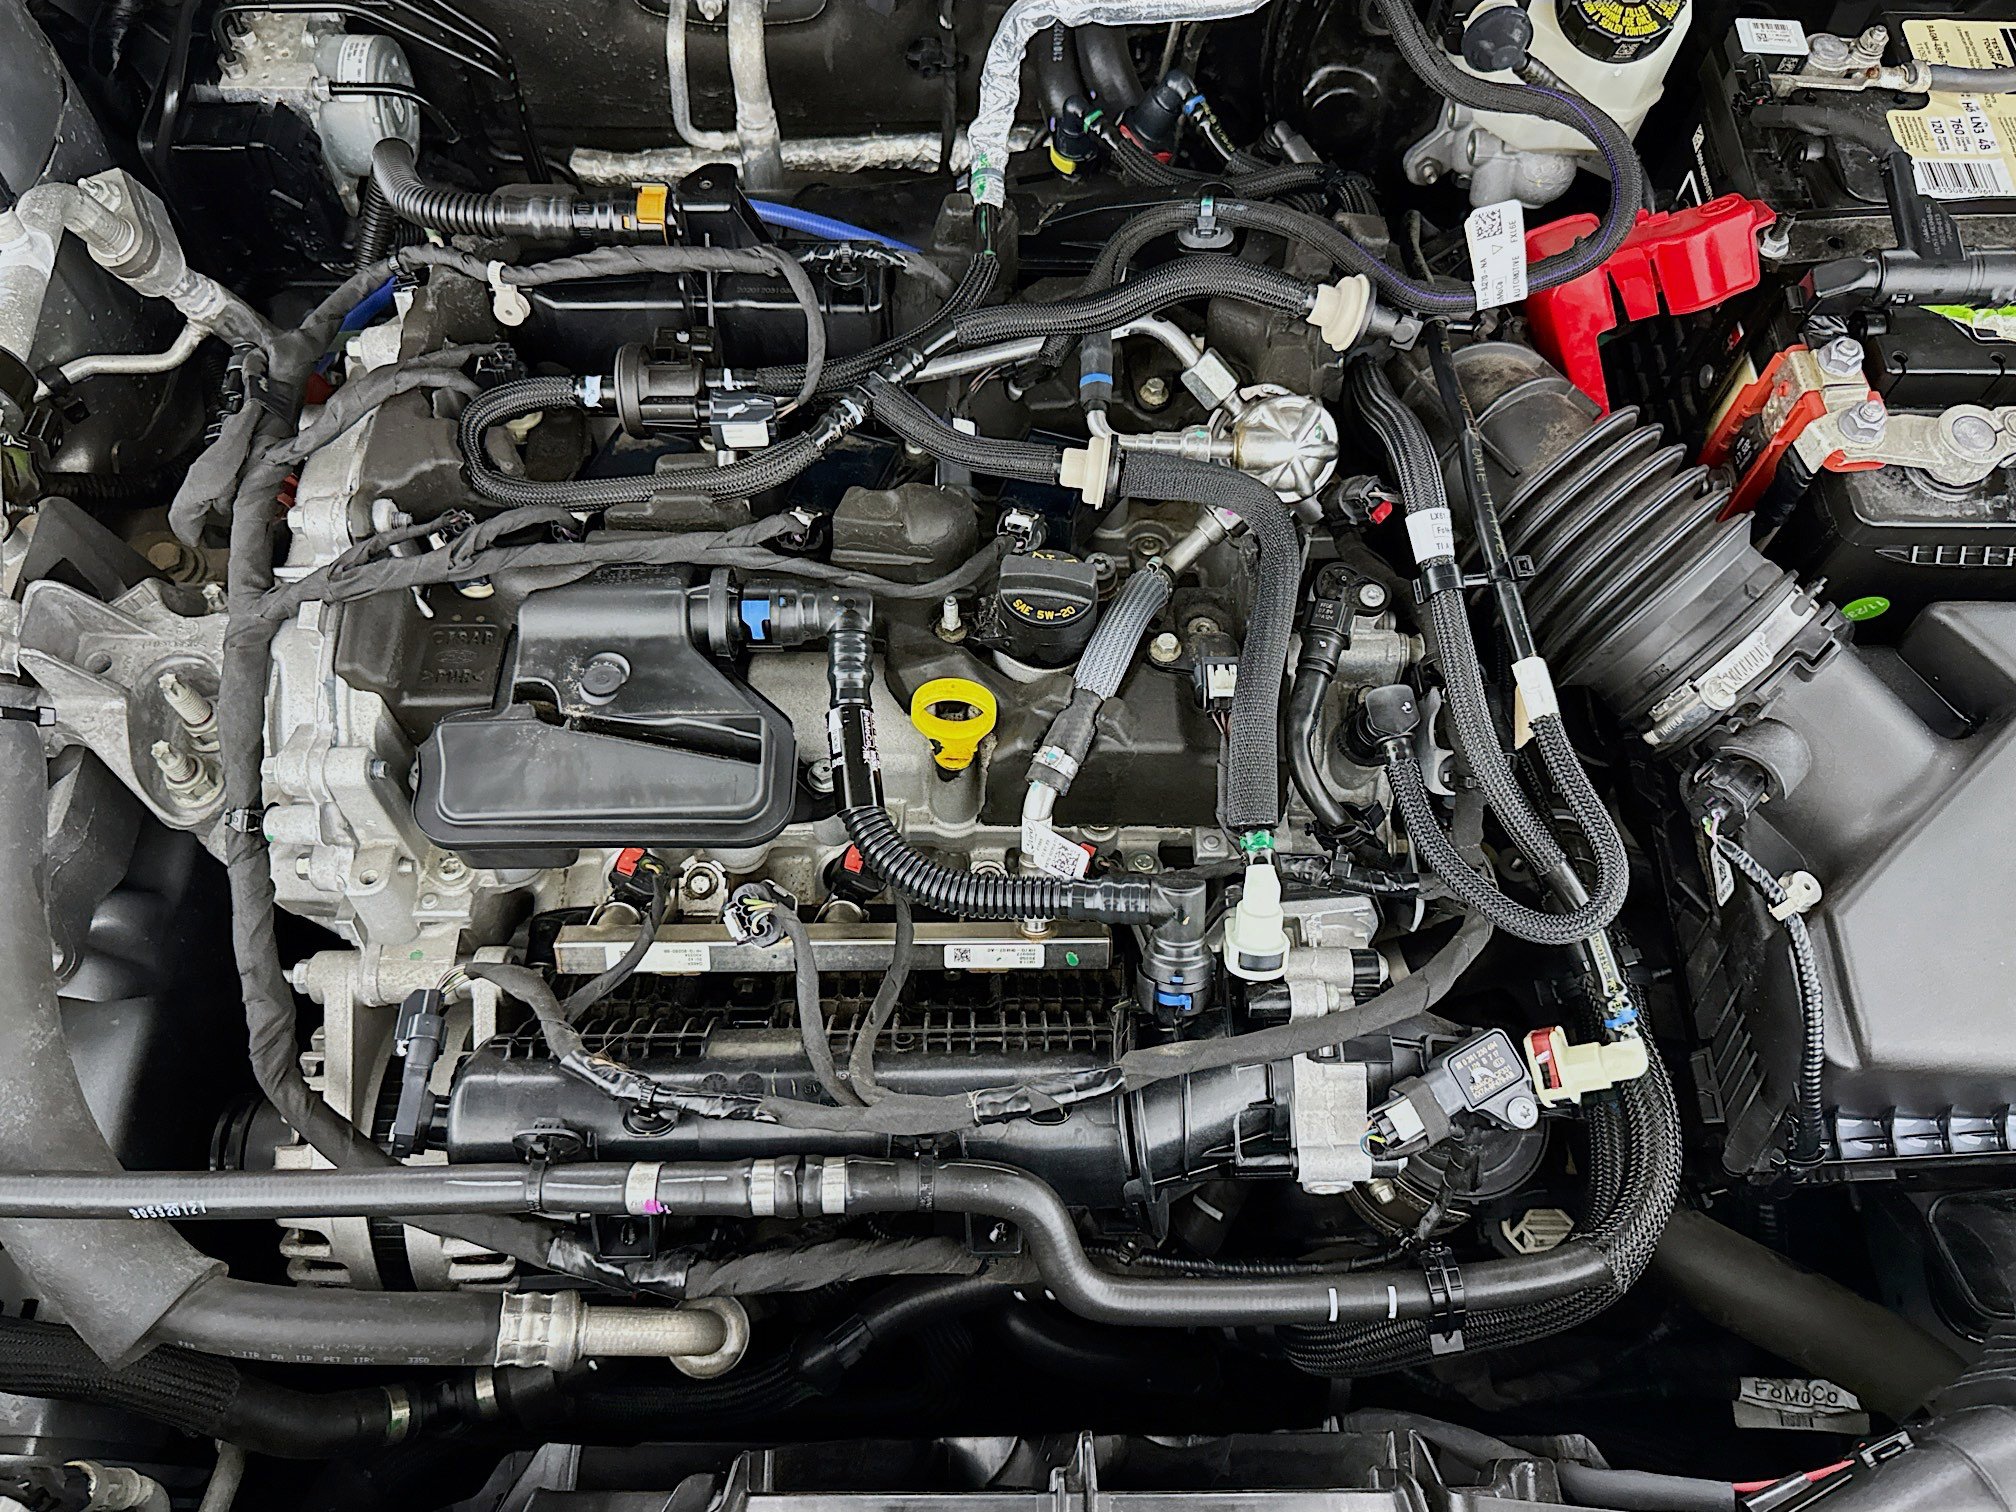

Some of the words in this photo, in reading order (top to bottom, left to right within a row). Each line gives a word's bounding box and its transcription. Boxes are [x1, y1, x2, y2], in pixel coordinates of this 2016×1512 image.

[1990, 37, 2005, 61] TESTED
[1930, 120, 1945, 134] 120
[1949, 118, 1965, 135] 760
[1977, 138, 1991, 151] 48
[1511, 255, 1521, 298] AUTOMOTIVE
[1472, 447, 1488, 482] DATE
[1012, 598, 1034, 616] SAE
[1036, 605, 1076, 620] 5W-20
[1755, 1381, 1838, 1404] FoMoCo
